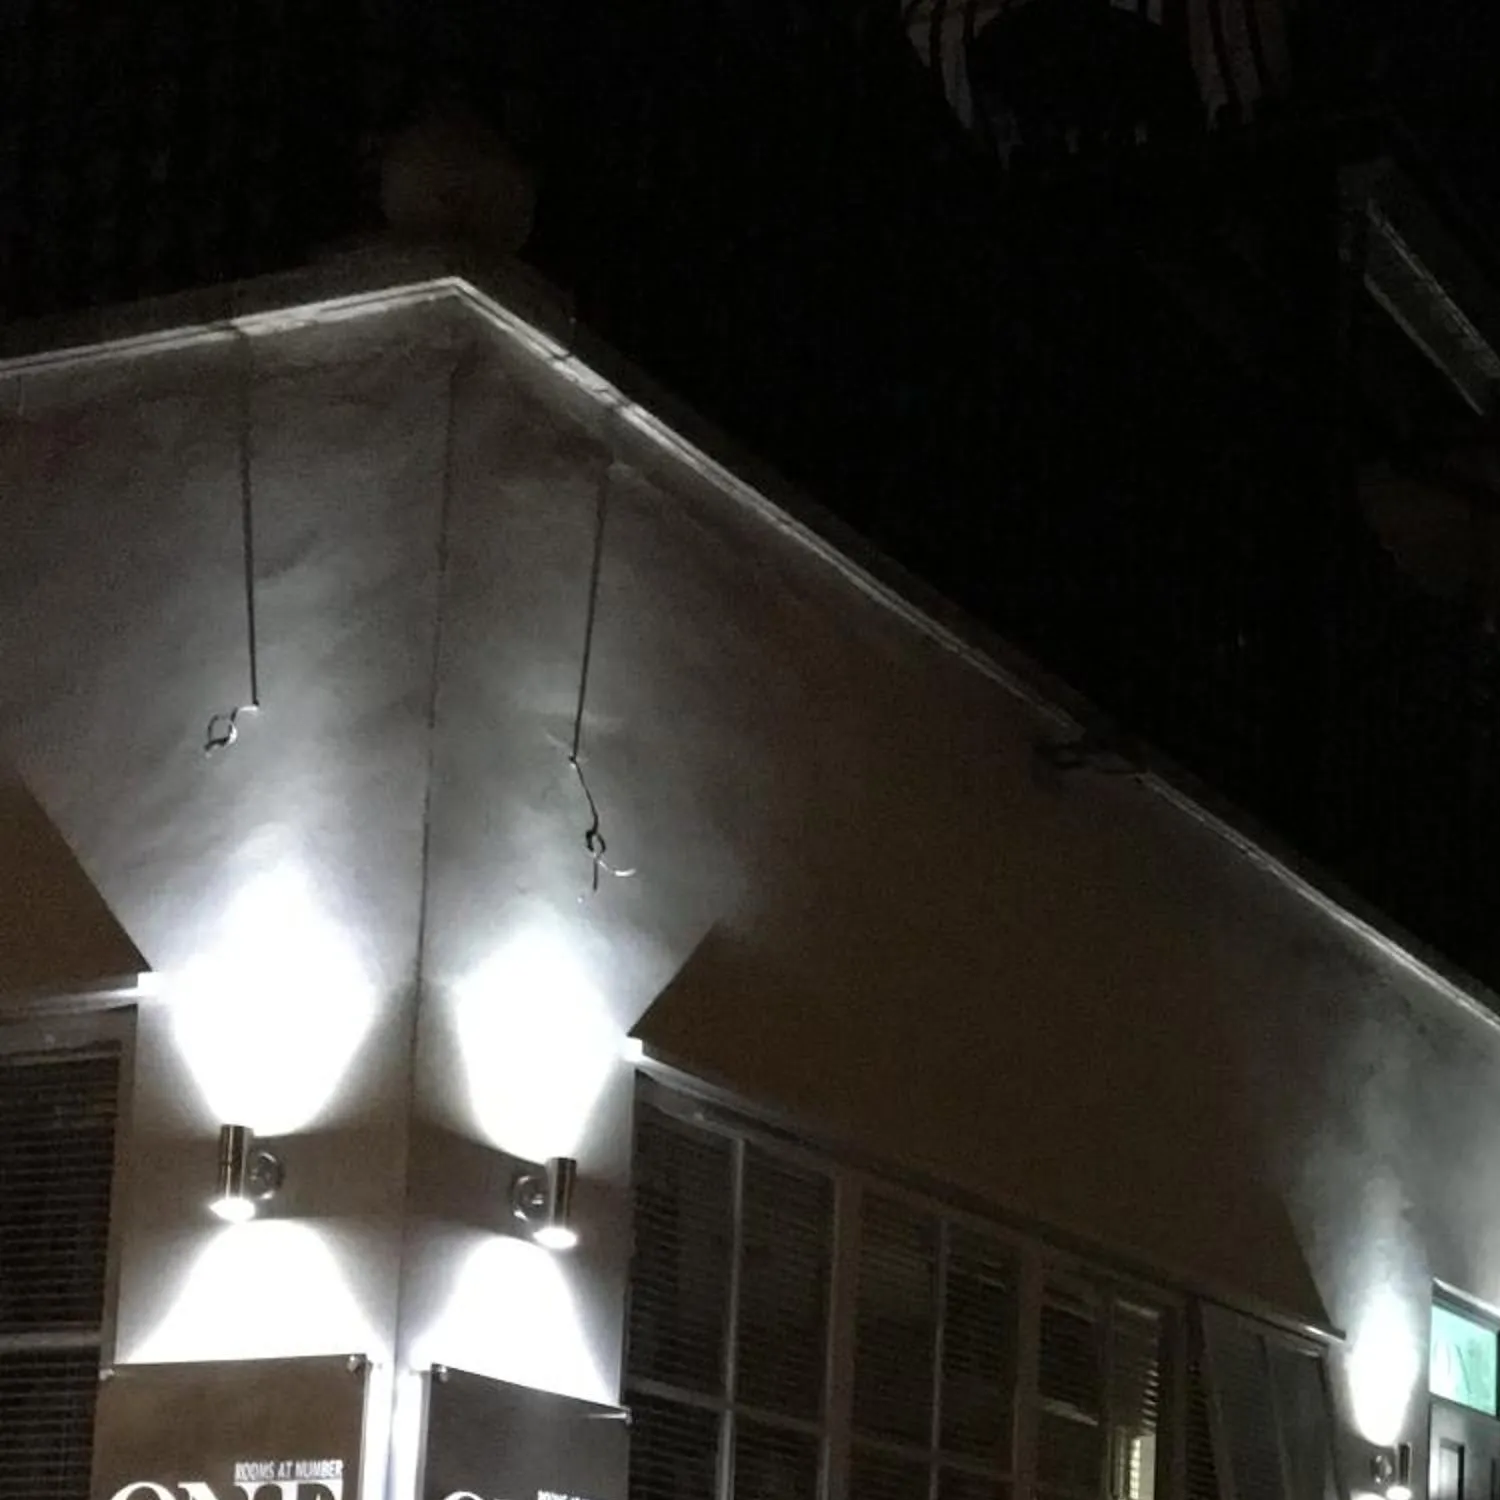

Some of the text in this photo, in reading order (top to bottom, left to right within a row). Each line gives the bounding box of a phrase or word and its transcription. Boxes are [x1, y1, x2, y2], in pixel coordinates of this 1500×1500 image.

[233, 1459, 343, 1481] ROOMS AT NUMBER
